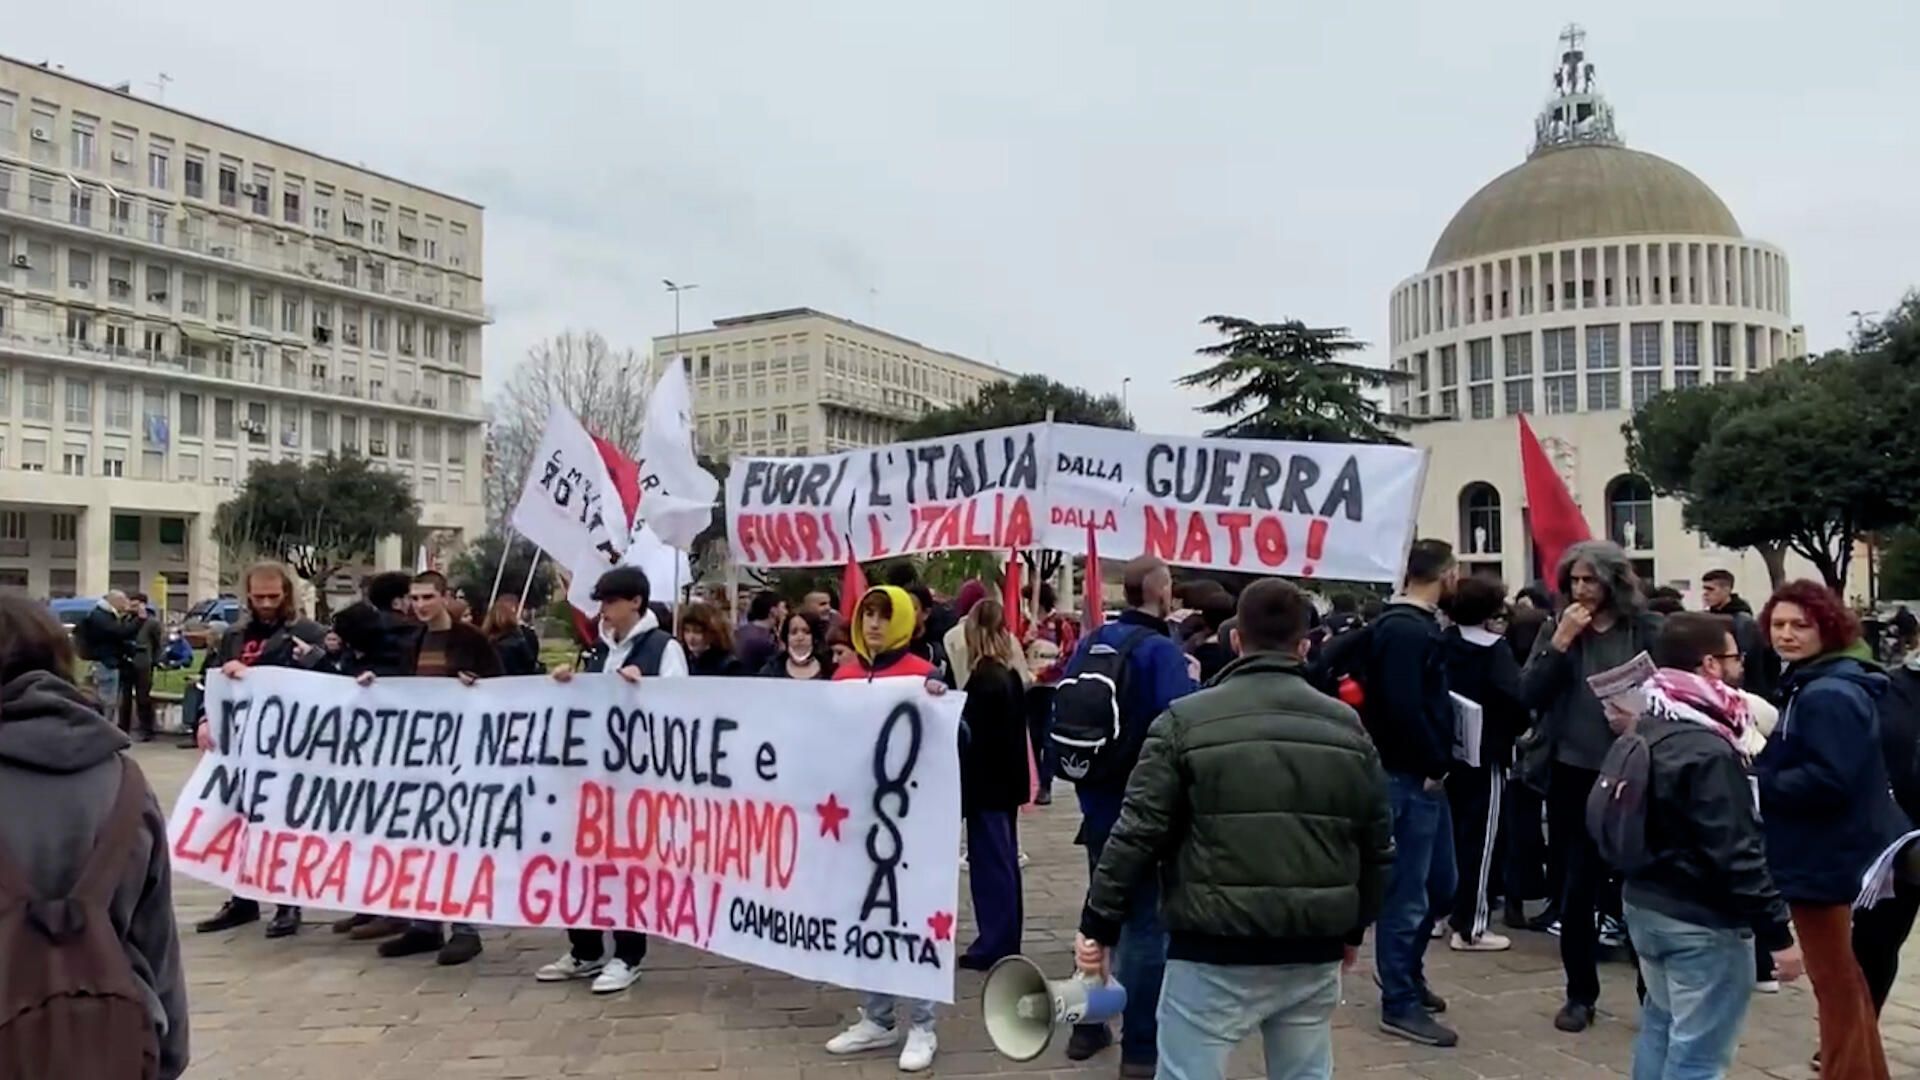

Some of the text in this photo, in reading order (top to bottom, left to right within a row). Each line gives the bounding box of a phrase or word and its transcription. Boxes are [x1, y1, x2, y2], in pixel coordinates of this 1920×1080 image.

[741, 456, 849, 507] FUORI
[868, 433, 1037, 506] L'ITALIA
[1056, 453, 1123, 482] DALLA
[1146, 443, 1363, 522] GUERRA
[737, 511, 841, 564] FUORI
[1051, 506, 1118, 531] DALLA
[1143, 505, 1329, 575] NATO!
[257, 694, 463, 775] QUARTIERI,
[475, 706, 592, 767] NELLE
[604, 707, 738, 787] SCUOLE
[756, 741, 778, 781] e
[174, 807, 243, 872] LA
[362, 846, 495, 919] DELLA
[518, 853, 722, 946] GUERRA!
[575, 781, 798, 889] BLOCCHIAMO
[730, 897, 836, 951] CAMBIARE
